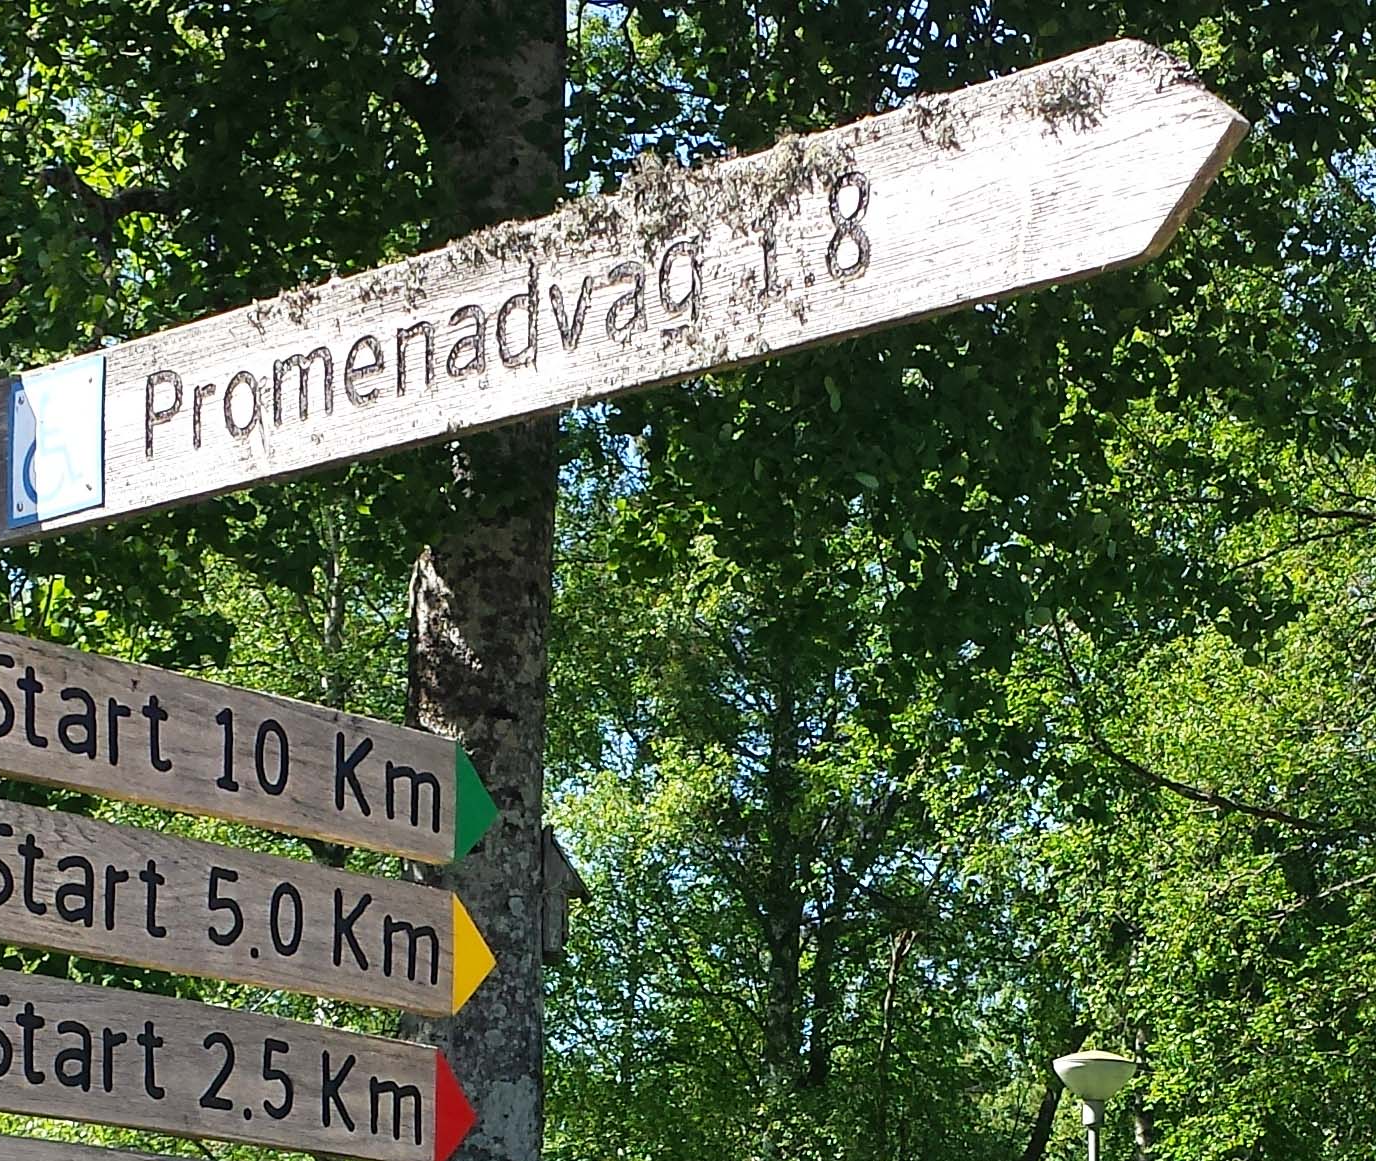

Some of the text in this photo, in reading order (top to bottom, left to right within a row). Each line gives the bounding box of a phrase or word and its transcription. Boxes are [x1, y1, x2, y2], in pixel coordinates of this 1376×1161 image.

[215, 706, 290, 796] 10
[334, 730, 442, 835] Km
[207, 866, 303, 959] 5.0
[332, 886, 440, 987] Km
[198, 1031, 295, 1121] 2.5
[321, 1049, 422, 1147] Km
